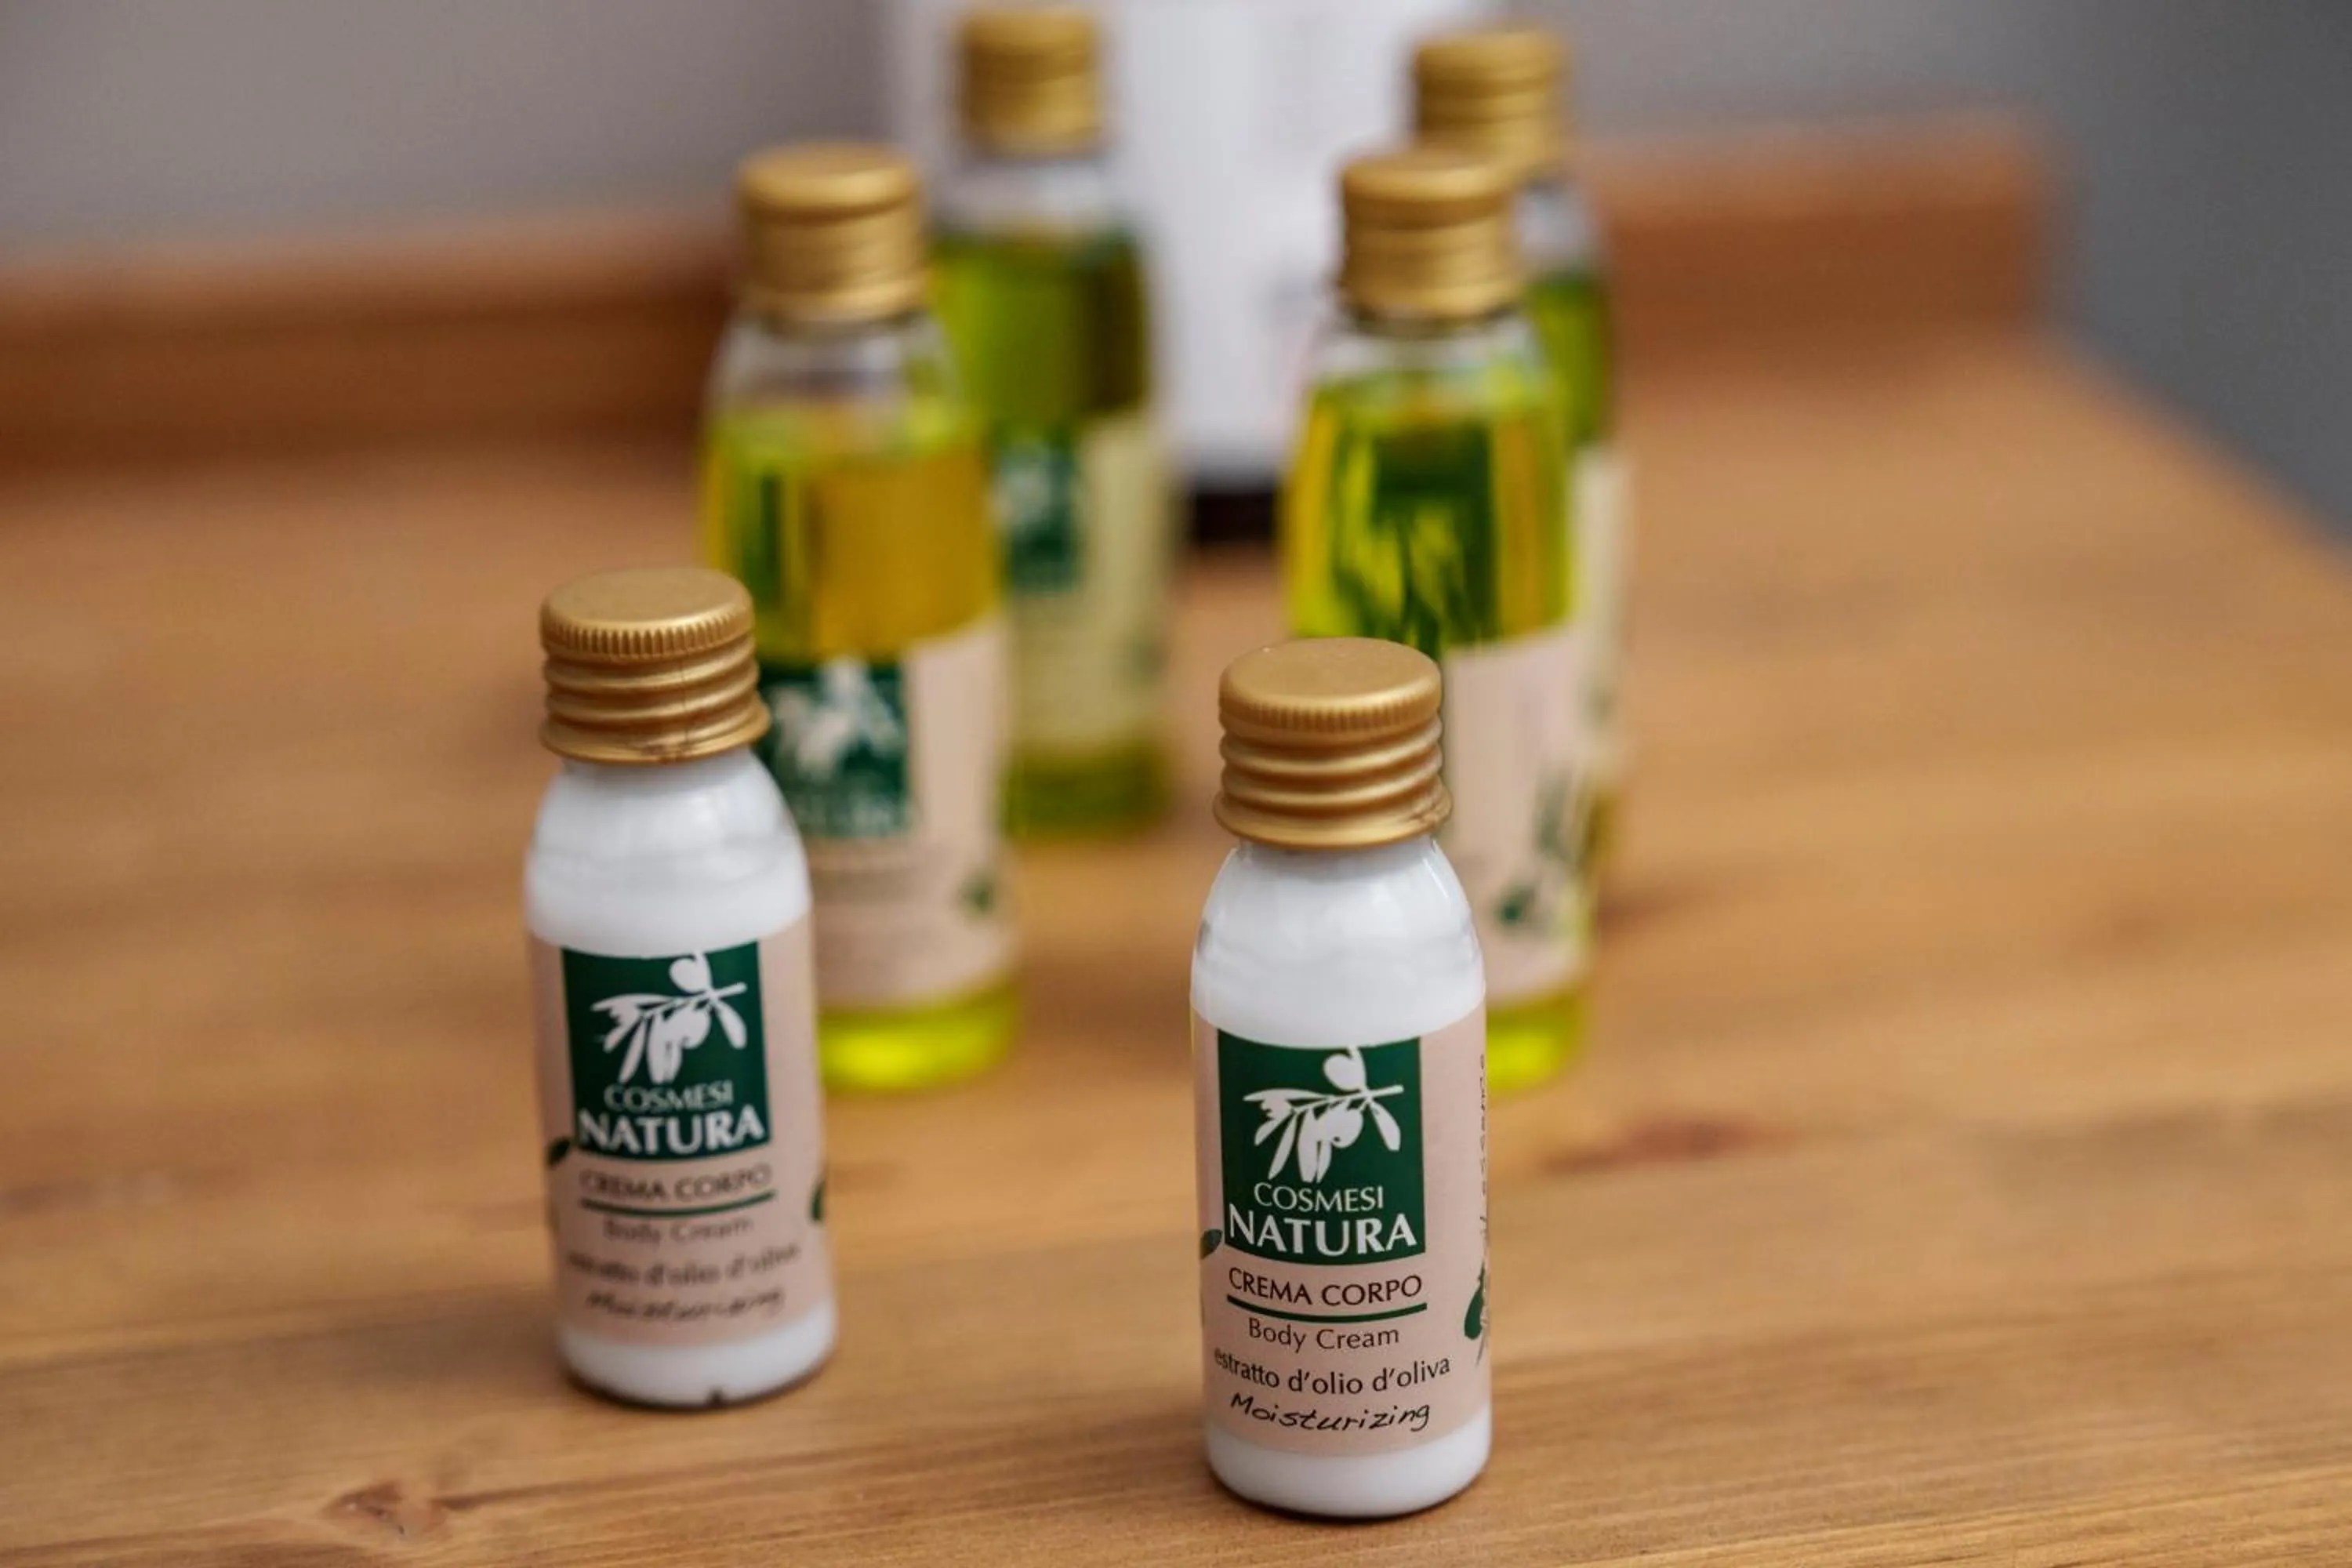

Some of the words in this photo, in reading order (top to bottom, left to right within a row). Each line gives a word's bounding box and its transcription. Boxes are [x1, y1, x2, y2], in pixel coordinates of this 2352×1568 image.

[603, 1079, 734, 1112] COSMESI
[577, 1104, 765, 1154] NATURA
[1254, 1181, 1384, 1213] COSMESI
[1229, 1203, 1417, 1256] NATURA
[1229, 1266, 1312, 1305] CREMA
[1321, 1275, 1422, 1306] CORPO
[1248, 1317, 1306, 1353] Body
[1316, 1328, 1399, 1349] Cream
[1214, 1346, 1280, 1388] estratto
[1288, 1368, 1363, 1395] d'olio
[1373, 1356, 1451, 1392] d'oliva
[1230, 1392, 1431, 1432] Moisturizing
